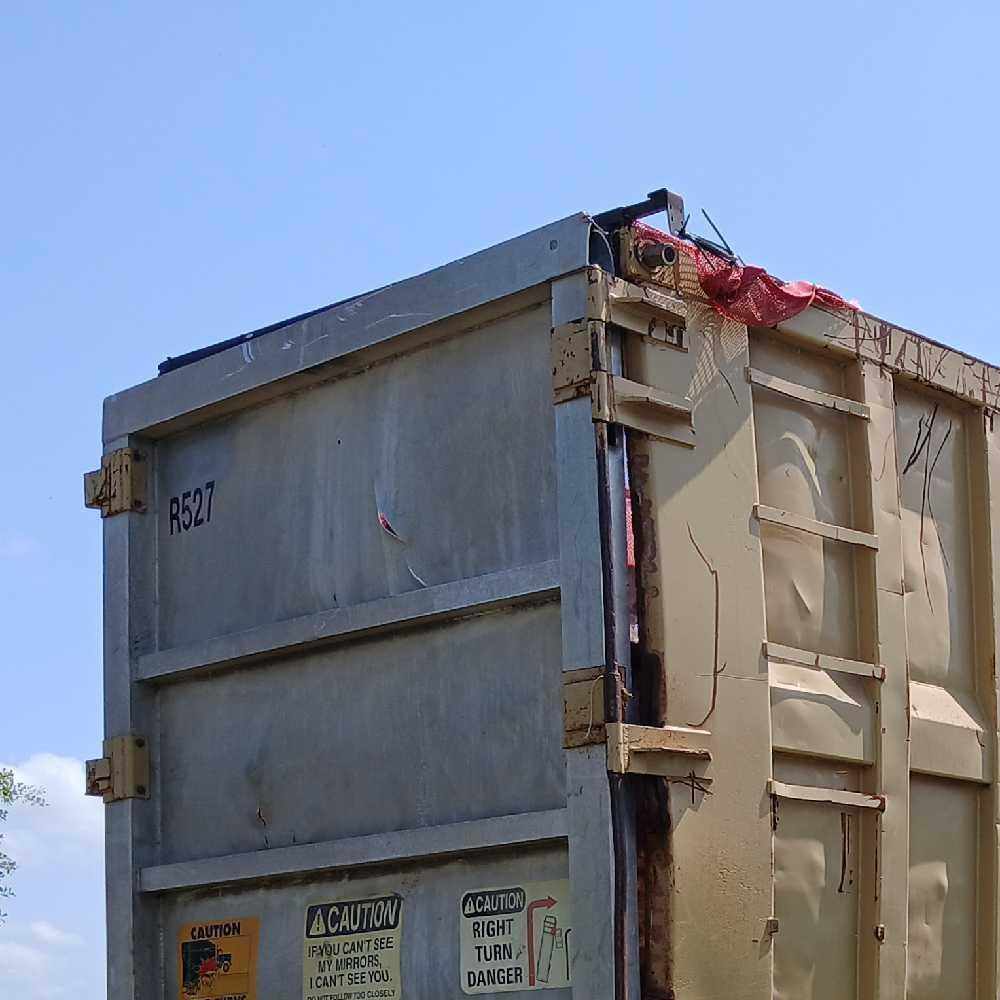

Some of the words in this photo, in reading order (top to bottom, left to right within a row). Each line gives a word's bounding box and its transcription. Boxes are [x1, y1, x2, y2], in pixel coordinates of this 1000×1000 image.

[169, 480, 215, 535] R527
[477, 891, 523, 913] CAUTION
[328, 899, 398, 933] CAUTION
[191, 922, 241, 940] CAUTION
[472, 918, 514, 938] RIGHT
[308, 946, 317, 958] IF
[318, 944, 340, 957] YOU
[373, 936, 394, 951] SEE
[474, 943, 513, 962] TURN
[318, 960, 333, 973] MY
[309, 976, 313, 989] I
[347, 971, 367, 985] SEE
[467, 966, 523, 988] DANGER
[367, 990, 396, 999] CLOSELY
